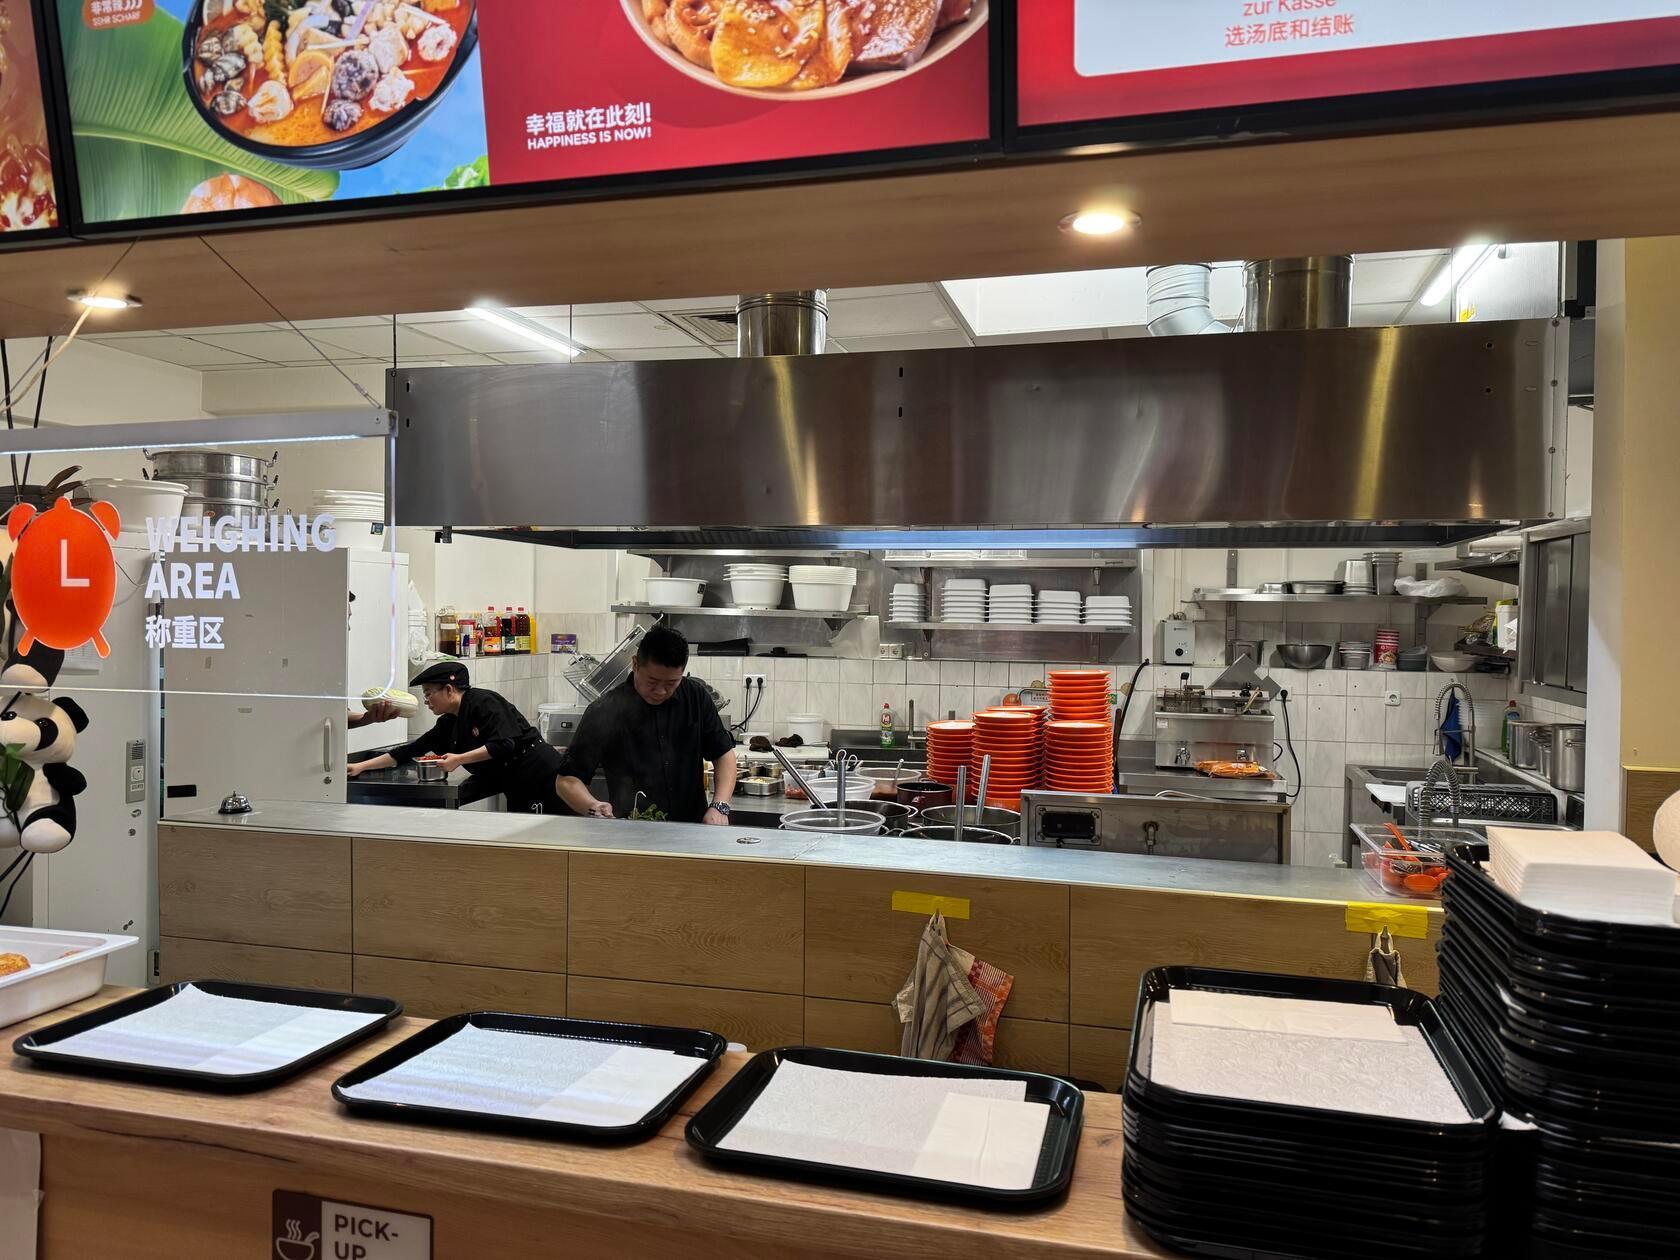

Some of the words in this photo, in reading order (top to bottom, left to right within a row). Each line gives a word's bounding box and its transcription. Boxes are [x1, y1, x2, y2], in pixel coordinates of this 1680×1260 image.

[1243, 0, 1272, 16] zur
[1224, 14, 1354, 47] 选汤底和结账
[526, 101, 652, 135] 幸福就在此刻!
[527, 131, 597, 150] HAPPINESS
[599, 130, 612, 143] IS
[614, 126, 652, 142] NOW!
[145, 513, 337, 553] WEIGHING
[144, 562, 241, 599] AREA
[145, 614, 225, 649] 称重区
[334, 1214, 399, 1241] PICK-
[334, 1241, 367, 1260] UP
